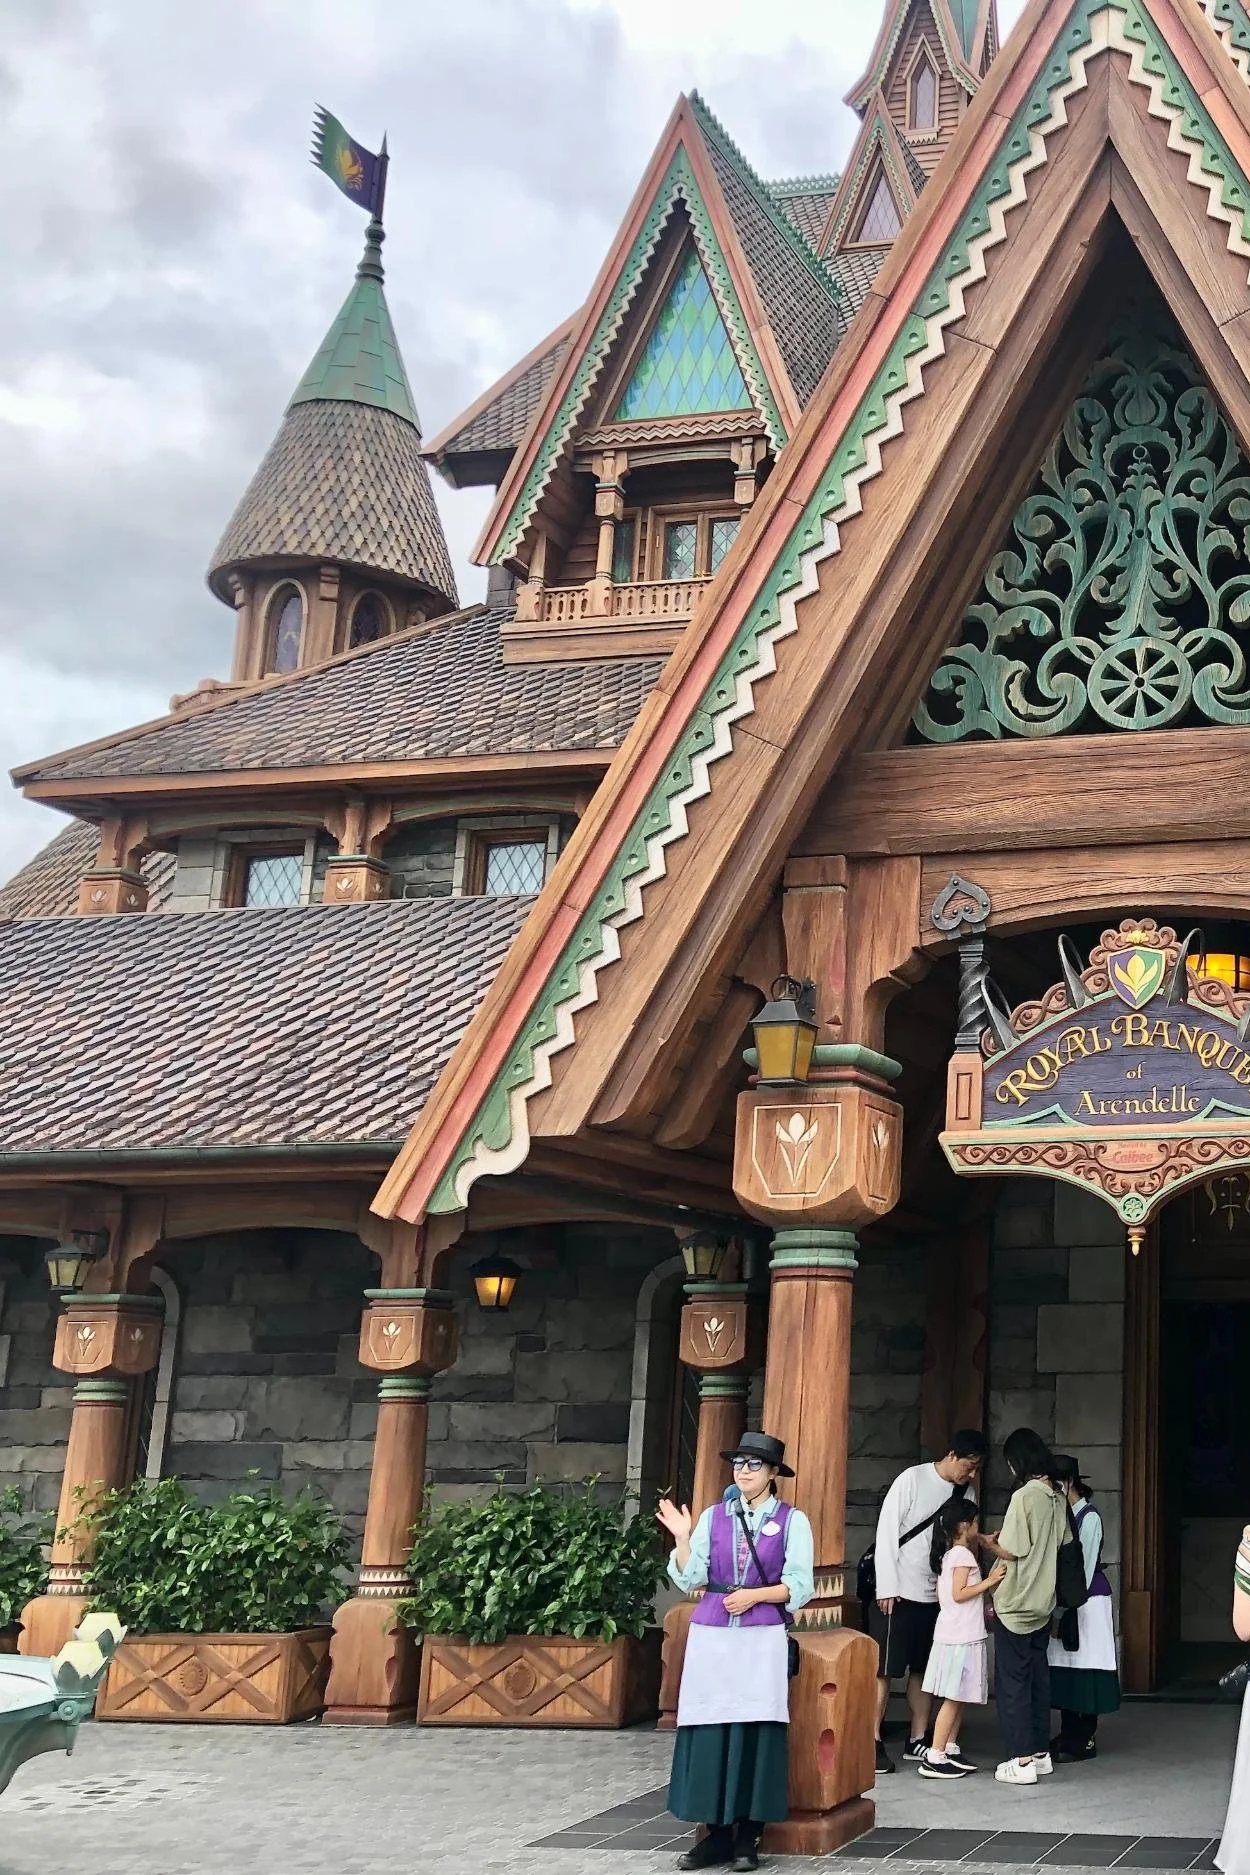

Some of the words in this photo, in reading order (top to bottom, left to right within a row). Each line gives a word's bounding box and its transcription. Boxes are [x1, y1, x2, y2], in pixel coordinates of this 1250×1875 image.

[995, 1025, 1112, 1106] ROYAL
[1126, 1061, 1147, 1080] of
[1074, 1085, 1201, 1117] Arendelle
